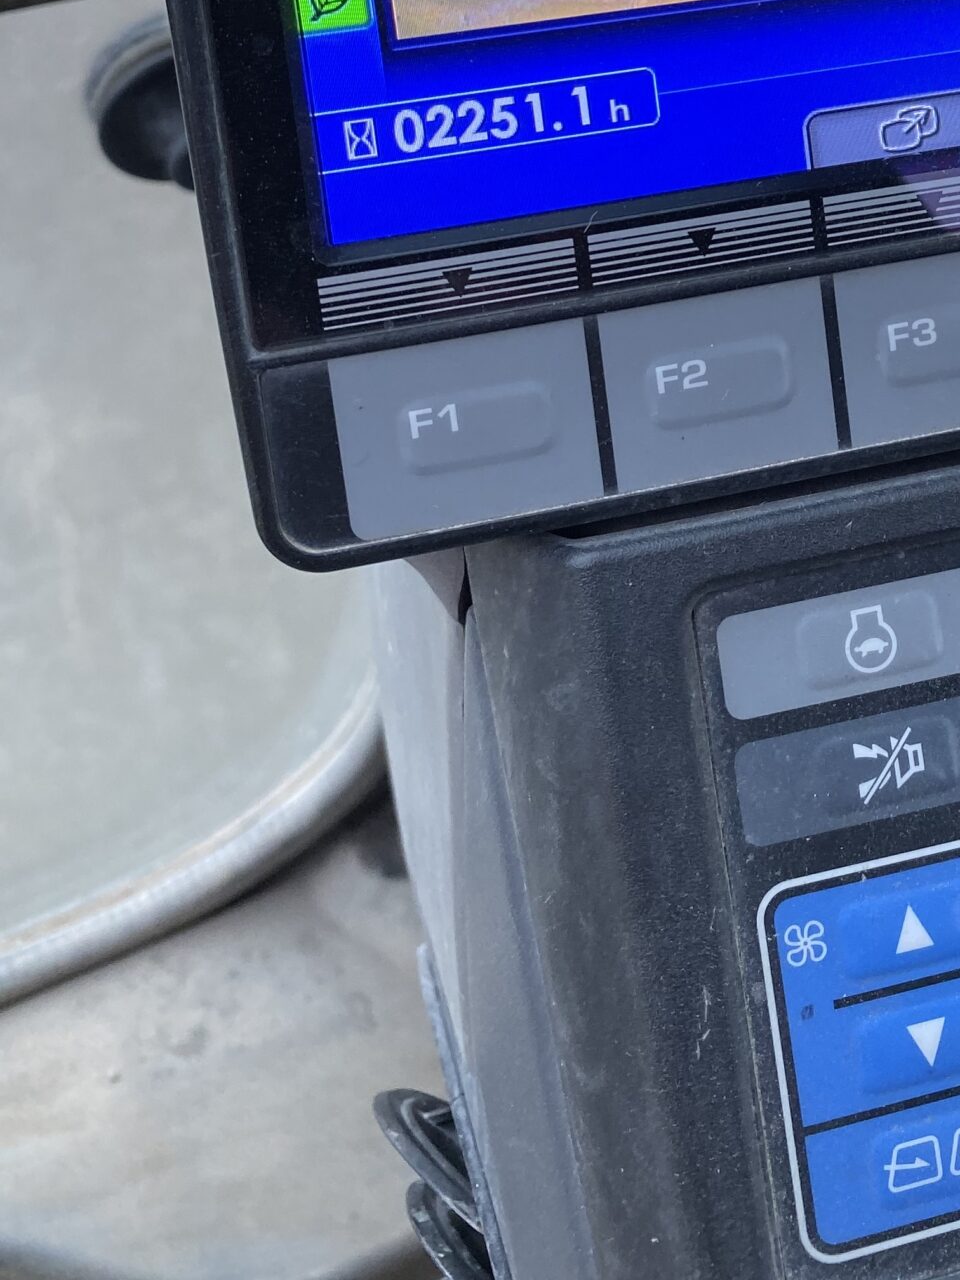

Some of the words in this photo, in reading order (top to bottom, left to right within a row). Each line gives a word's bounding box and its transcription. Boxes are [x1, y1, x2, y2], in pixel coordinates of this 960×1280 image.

[393, 84, 594, 155] 02251.1
[609, 97, 631, 124] h
[884, 316, 940, 354] F3
[654, 358, 710, 395] F2
[407, 402, 461, 441] F1
